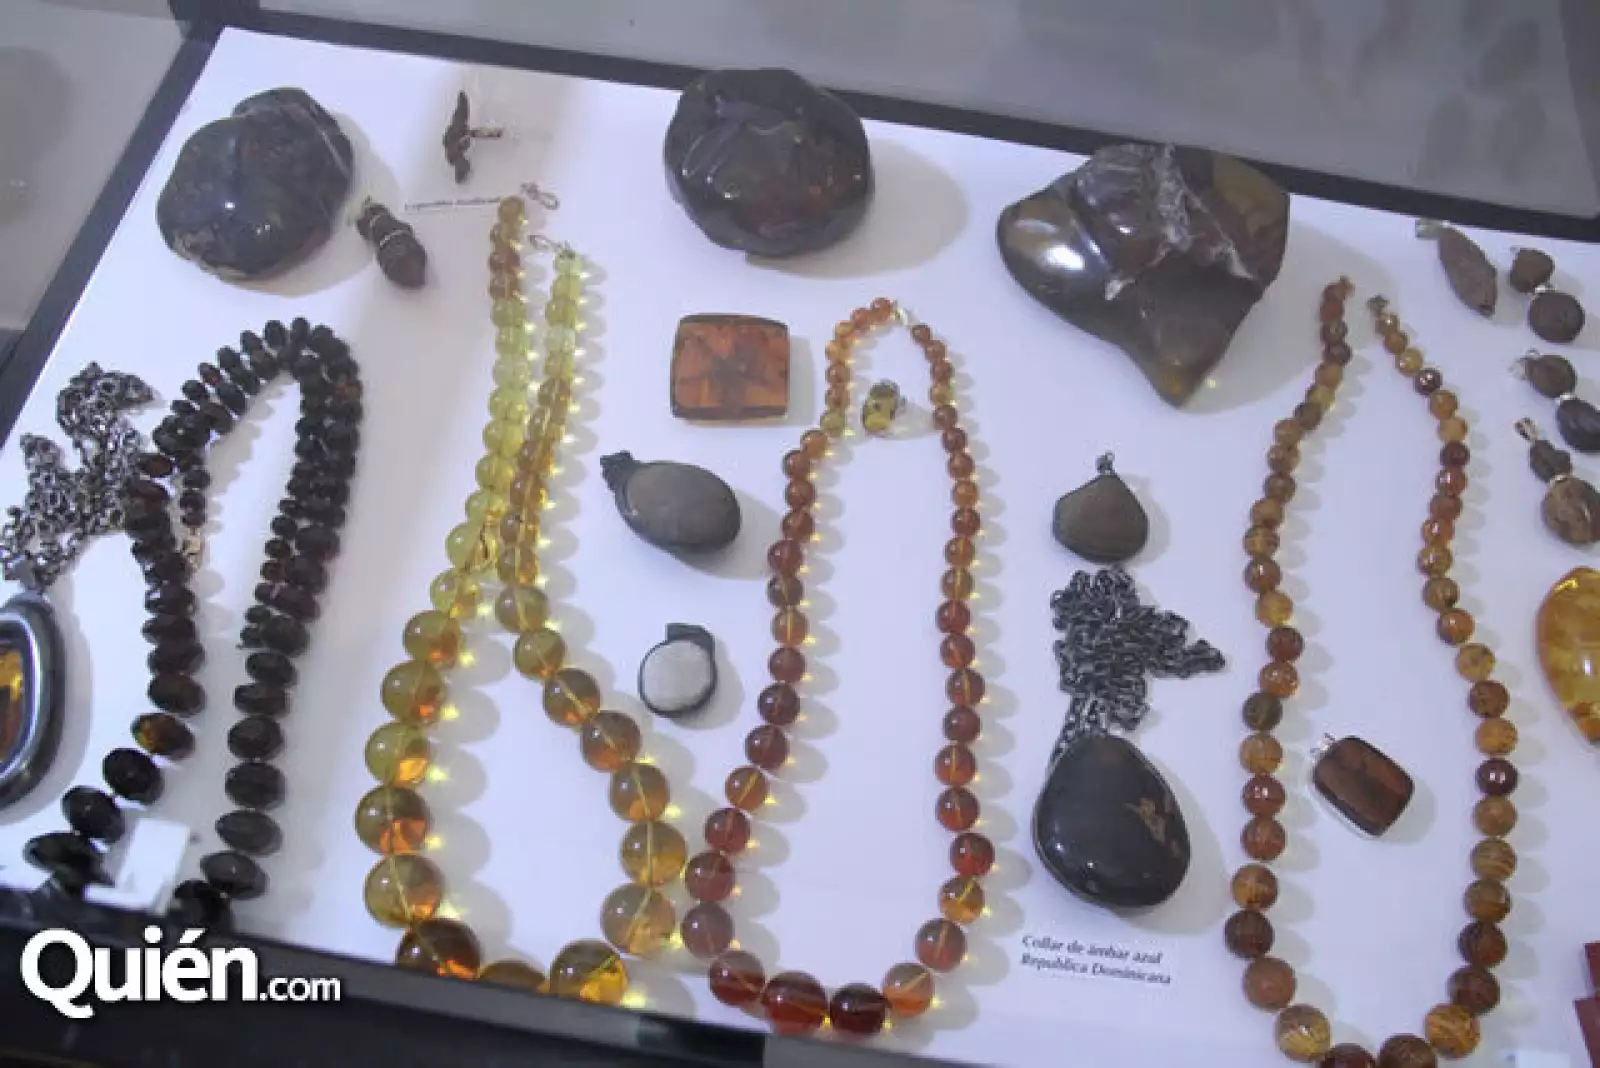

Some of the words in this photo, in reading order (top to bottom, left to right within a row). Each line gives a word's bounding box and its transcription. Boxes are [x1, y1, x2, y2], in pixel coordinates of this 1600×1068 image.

[1021, 935, 1064, 951] Collar
[1066, 939, 1085, 954] de
[1132, 951, 1164, 964] azul
[1091, 961, 1172, 984] Dominicana
